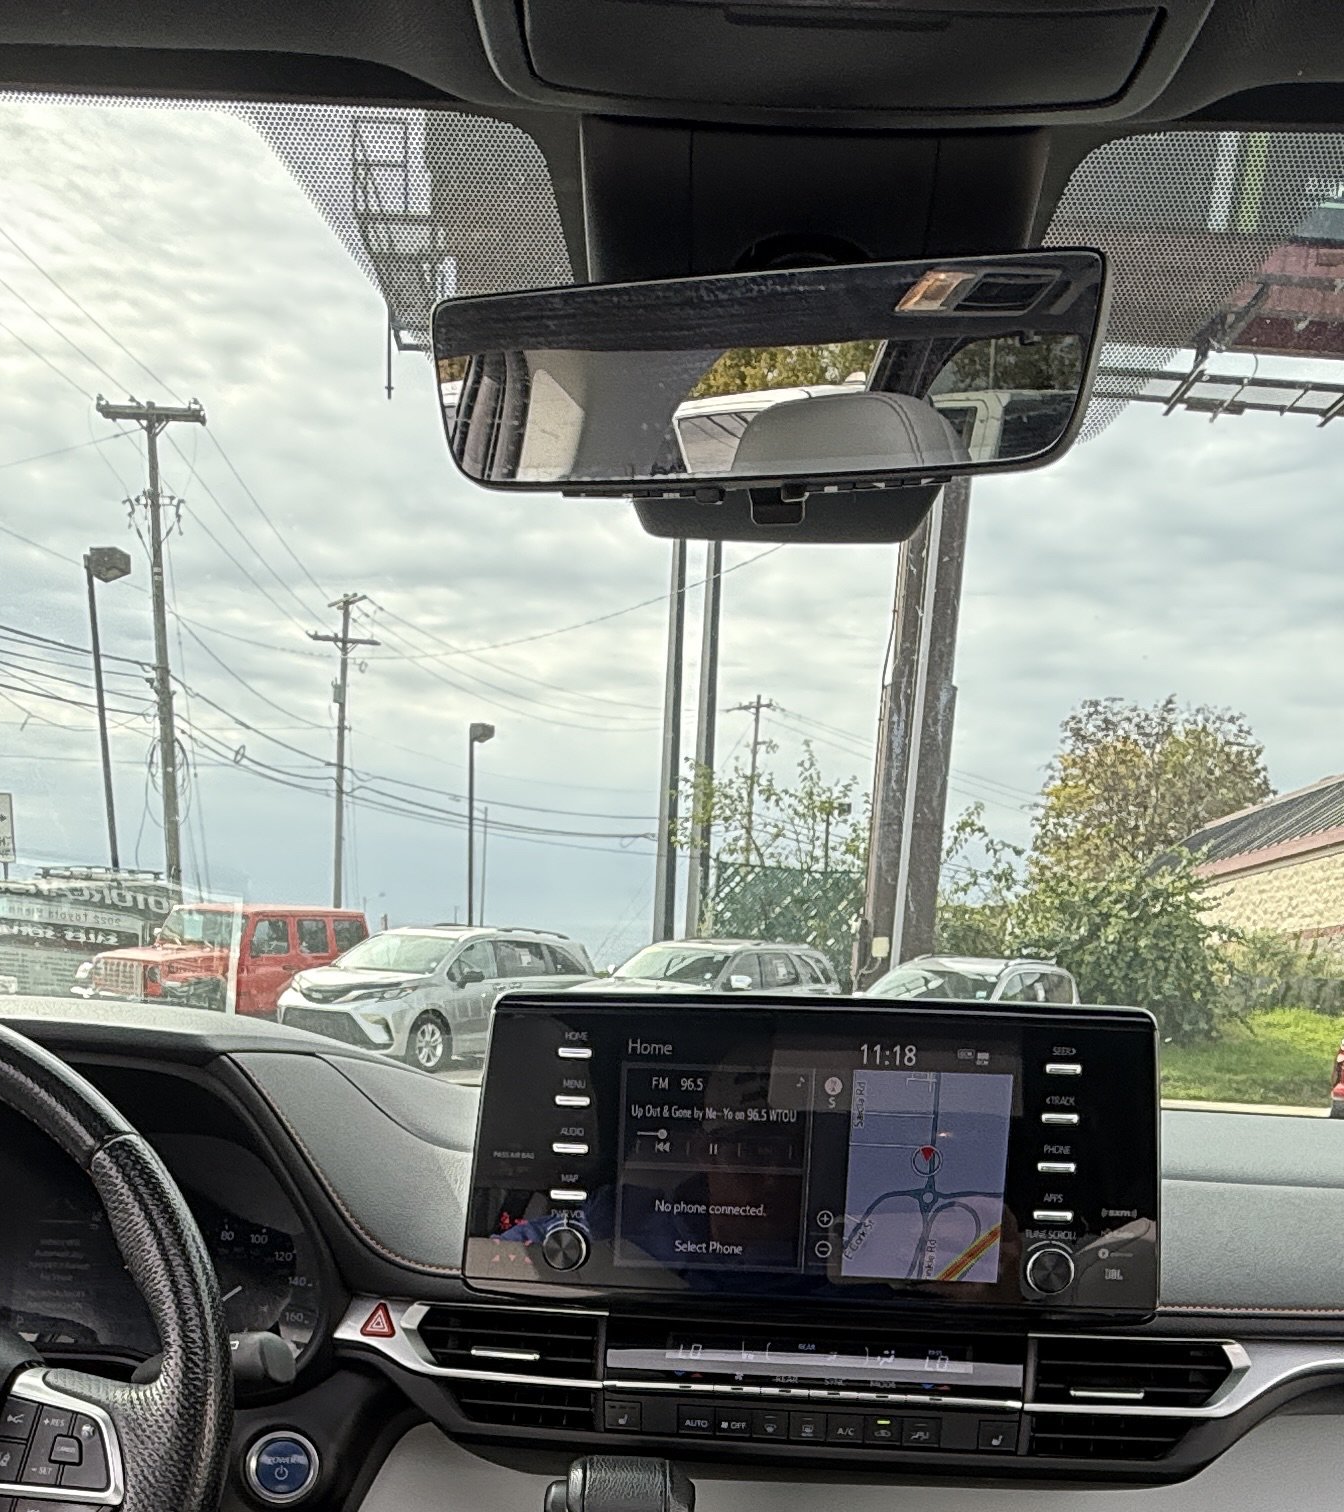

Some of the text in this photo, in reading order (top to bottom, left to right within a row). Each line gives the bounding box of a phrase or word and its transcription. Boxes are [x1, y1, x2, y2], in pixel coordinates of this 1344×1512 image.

[565, 1031, 588, 1041] HOME
[628, 1038, 673, 1055] Home
[860, 1043, 917, 1066] 11:18
[563, 1078, 586, 1089] MENU
[652, 1077, 704, 1091] FM 96.5
[828, 1096, 836, 1109] S
[1051, 1096, 1075, 1106] TRACK
[631, 1104, 644, 1119] Up
[645, 1104, 661, 1118] Out
[662, 1105, 670, 1118] &
[671, 1105, 692, 1119] Gone
[693, 1106, 703, 1121] by
[735, 1111, 745, 1121] on
[747, 1108, 767, 1121] 96.5
[769, 1108, 797, 1122] WTOU
[560, 1127, 585, 1137] AUDIO
[1043, 1144, 1071, 1154] PHONE
[560, 1173, 579, 1183] MAP
[1043, 1193, 1064, 1203] APPS
[655, 1200, 767, 1217] No phone connected.
[220, 1230, 234, 1241] 80
[250, 1234, 268, 1244] 100
[674, 1240, 743, 1255] Select Phone
[274, 1251, 293, 1261] 120
[288, 1276, 306, 1287] 140
[285, 1312, 303, 1321] 160
[684, 1419, 709, 1428] AUTO
[730, 1421, 747, 1429] OFF
[837, 1427, 855, 1436] A/C
